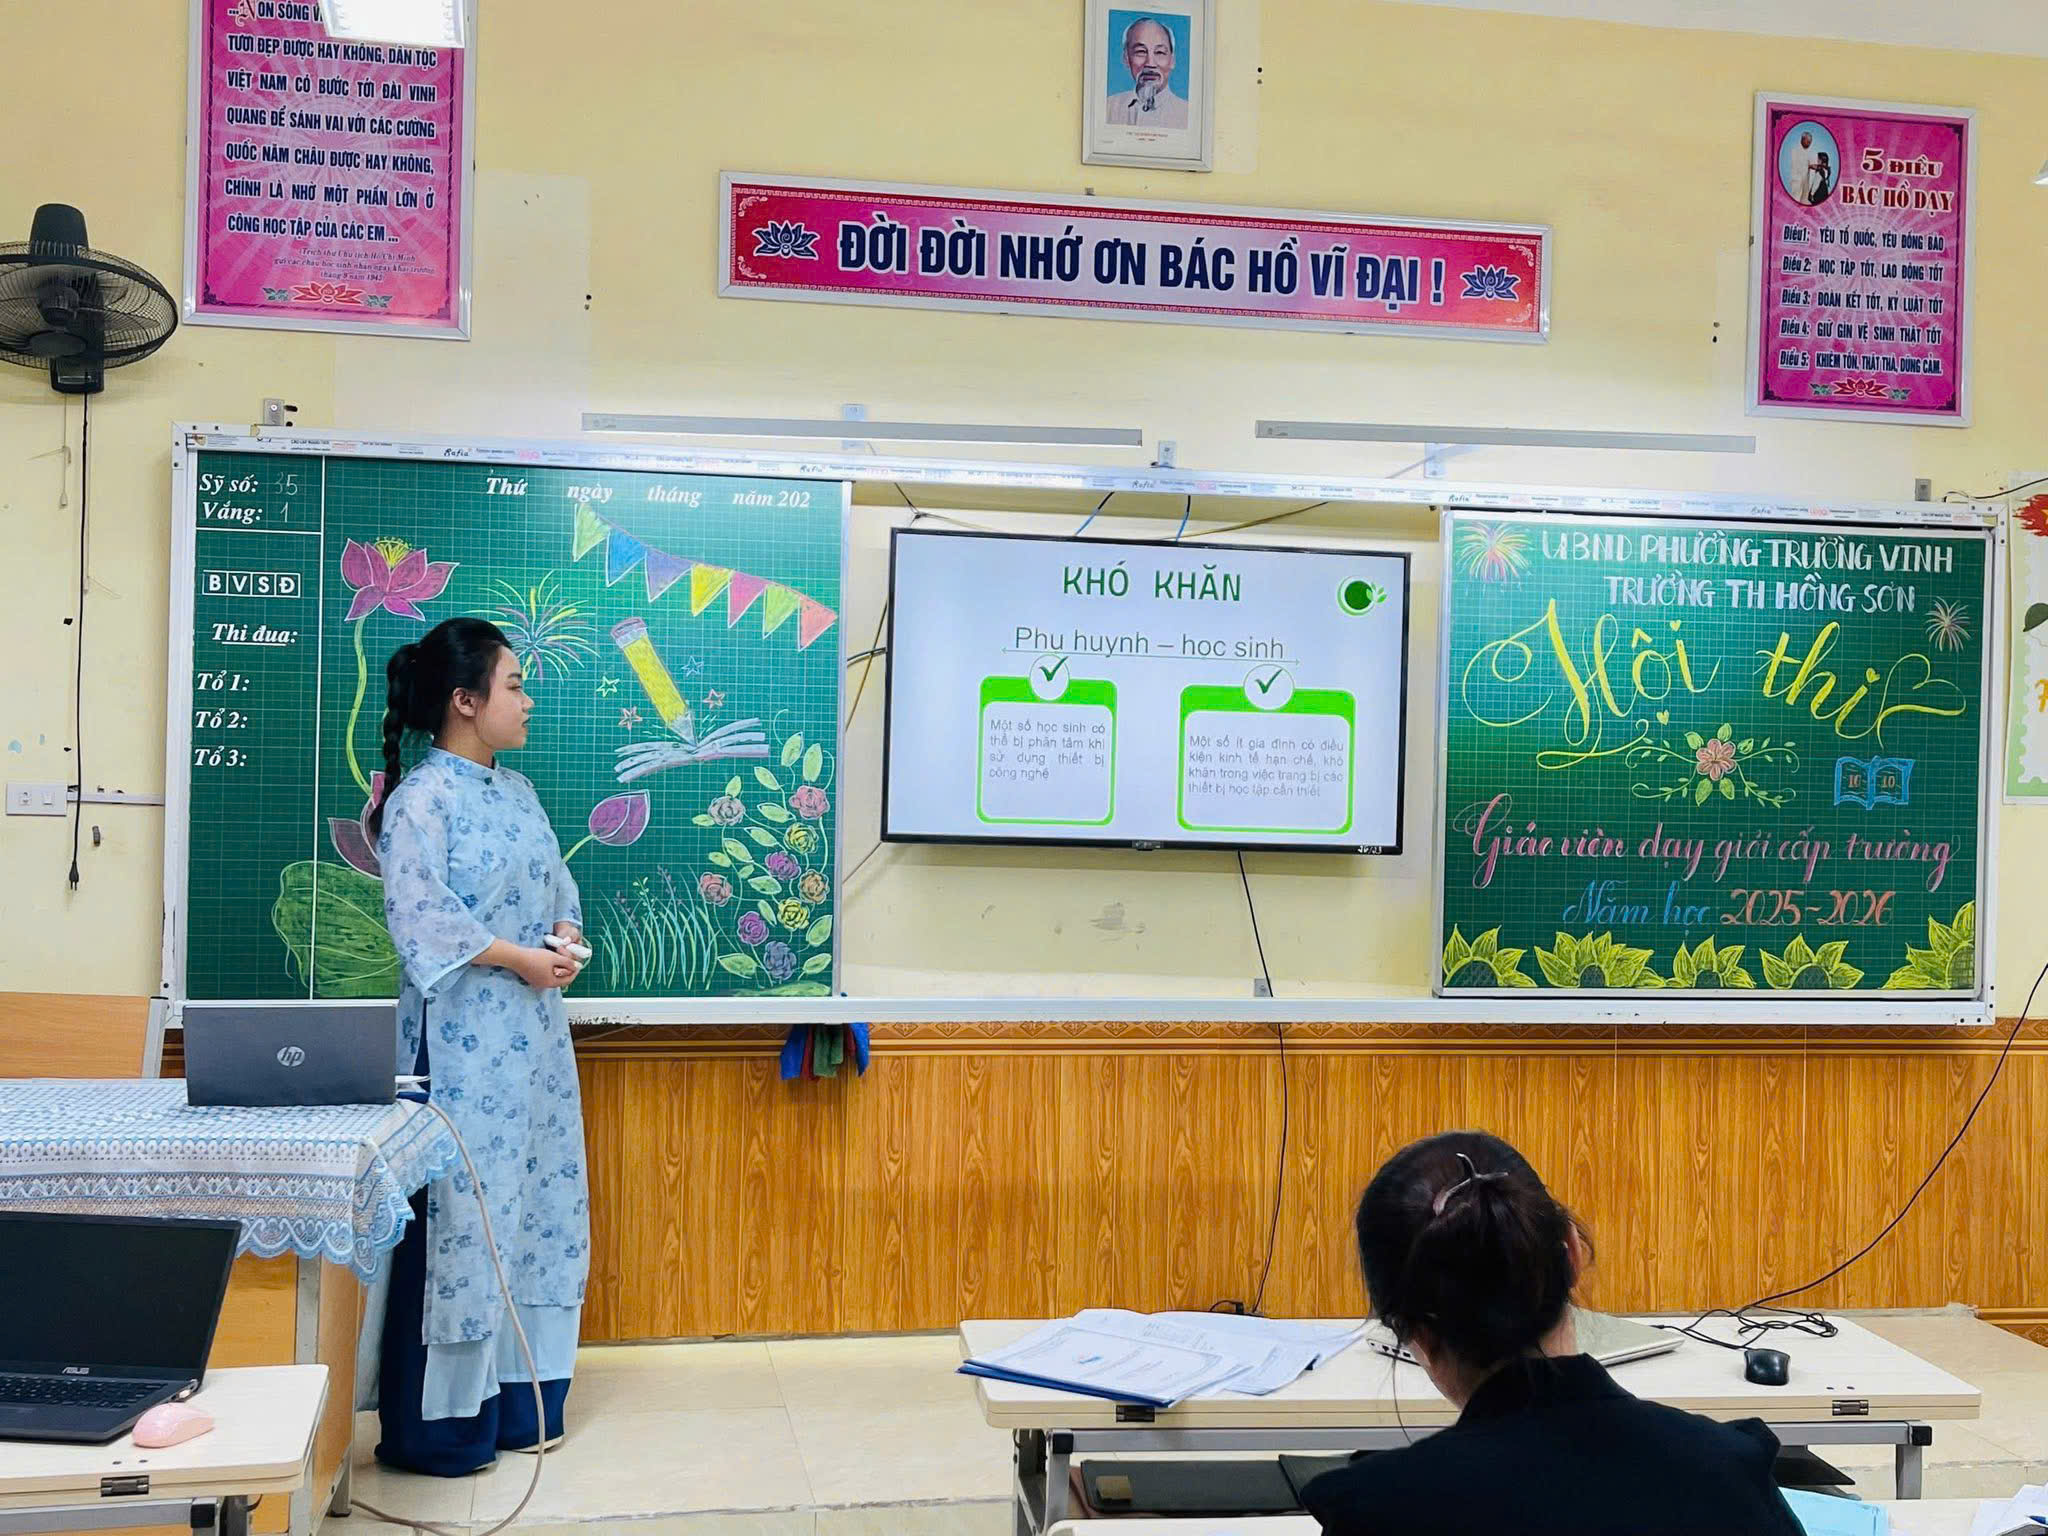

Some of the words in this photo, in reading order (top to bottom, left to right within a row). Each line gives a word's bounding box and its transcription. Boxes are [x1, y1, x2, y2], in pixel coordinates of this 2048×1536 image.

[278, 1, 309, 20] SÔNG
[228, 35, 254, 52] TƯƠI
[257, 38, 279, 57] ĐẸP
[284, 40, 313, 60] ĐƯỢC
[318, 43, 339, 59] HAY
[343, 43, 385, 64] KHÔNG,
[389, 46, 412, 64] DÂN
[416, 48, 436, 69] TỘC
[228, 69, 252, 91] VIỆT
[260, 74, 287, 90] NAM
[295, 75, 310, 92] CÓ
[319, 75, 349, 95] BƯỚC
[357, 78, 374, 97] TỚI
[382, 81, 401, 100] ĐÀI
[409, 85, 435, 101] VINH
[227, 107, 266, 125] QUANG
[271, 105, 285, 127] ĐỂ
[290, 110, 321, 129] SÁNH
[325, 115, 343, 131] VAI
[347, 113, 365, 132] VỚI
[370, 116, 392, 134] CÁC
[397, 117, 434, 137] CƯỜNG
[226, 139, 257, 160] QUỐC
[262, 144, 289, 163] NĂM
[295, 147, 325, 165] CHÂU
[330, 151, 360, 171] ĐƯỢC
[366, 154, 387, 170] HAY
[392, 153, 434, 174] KHÔNG,
[1863, 150, 1883, 171] 5
[1889, 155, 1941, 176] ĐIỀU
[225, 177, 261, 196] CHÍNH
[270, 180, 283, 198] LÀ
[292, 181, 316, 200] NHỜ
[324, 184, 348, 206] MỘT
[396, 188, 417, 207] LỚN
[426, 187, 434, 208] Ở
[1842, 181, 1878, 206] BÁC
[1884, 180, 1910, 208] HỒ
[1914, 190, 1953, 215] DẠY
[228, 213, 260, 232] CÔNG
[263, 218, 287, 237] HỌC
[290, 217, 311, 239] TẬP
[315, 216, 338, 238] CỦA
[341, 221, 364, 239] CÁC
[368, 225, 385, 241] EM
[840, 214, 906, 271] ĐỜI
[920, 219, 986, 277] ĐỜI
[1000, 225, 1083, 282] NHỚ
[1094, 238, 1146, 286] ƠN
[1160, 237, 1235, 291] BÁC
[1249, 237, 1298, 295] HỒ
[1311, 246, 1347, 297] VĨ
[1356, 256, 1418, 310] ĐẠI
[1819, 259, 1835, 277] HỌC
[1882, 264, 1897, 278] LAO
[1929, 261, 1943, 281] TỐT
[1874, 326, 1895, 341] SINH
[199, 473, 225, 495] Sỹ
[229, 474, 258, 493] số:
[487, 477, 528, 496] Thứ
[568, 484, 613, 504] ngày
[648, 483, 702, 507] tháng
[733, 490, 772, 506] năm
[776, 490, 811, 507] 202
[203, 500, 263, 525] Vắng:
[280, 501, 289, 523] 1
[1543, 530, 1632, 561] UBND
[1641, 529, 1761, 566] PHƯỜNG
[1762, 536, 1872, 571] TRƯỜNG
[1879, 544, 1953, 573] VINH
[1063, 560, 1129, 597] KHÓ
[1154, 564, 1241, 601] KHĂN
[1604, 569, 1717, 606] TRƯỜNG
[1725, 578, 1766, 609] TH
[1775, 574, 1857, 612] HỒNG
[1862, 582, 1915, 613] SƠN
[212, 623, 248, 642] Thi
[252, 625, 298, 644] đua:
[1074, 629, 1149, 658] huynh
[1234, 636, 1284, 658] sinh
[197, 670, 228, 691] Tổ
[229, 674, 250, 691] 1:
[1463, 598, 1721, 769] Hội
[1755, 621, 1967, 748] thi
[195, 708, 226, 729] Tổ
[227, 712, 248, 729] 2:
[990, 719, 1012, 733] Một
[1037, 721, 1057, 734] học
[1063, 722, 1086, 733] sinh
[1092, 722, 1105, 733] có
[194, 746, 225, 767] Tổ
[226, 750, 247, 767] 3:
[1063, 737, 1083, 748] tâm
[1088, 738, 1105, 749] khi
[1017, 752, 1046, 766] dụng
[1220, 769, 1248, 781] trong
[1453, 793, 1554, 889] Giáo
[1561, 828, 1626, 858] viên
[1638, 821, 1704, 881] dạy
[1715, 831, 1770, 883] giỏi
[1779, 825, 1831, 884] cấp
[1847, 829, 1960, 892] trường
[1563, 879, 1649, 926] Năm
[1663, 880, 1709, 936] học
